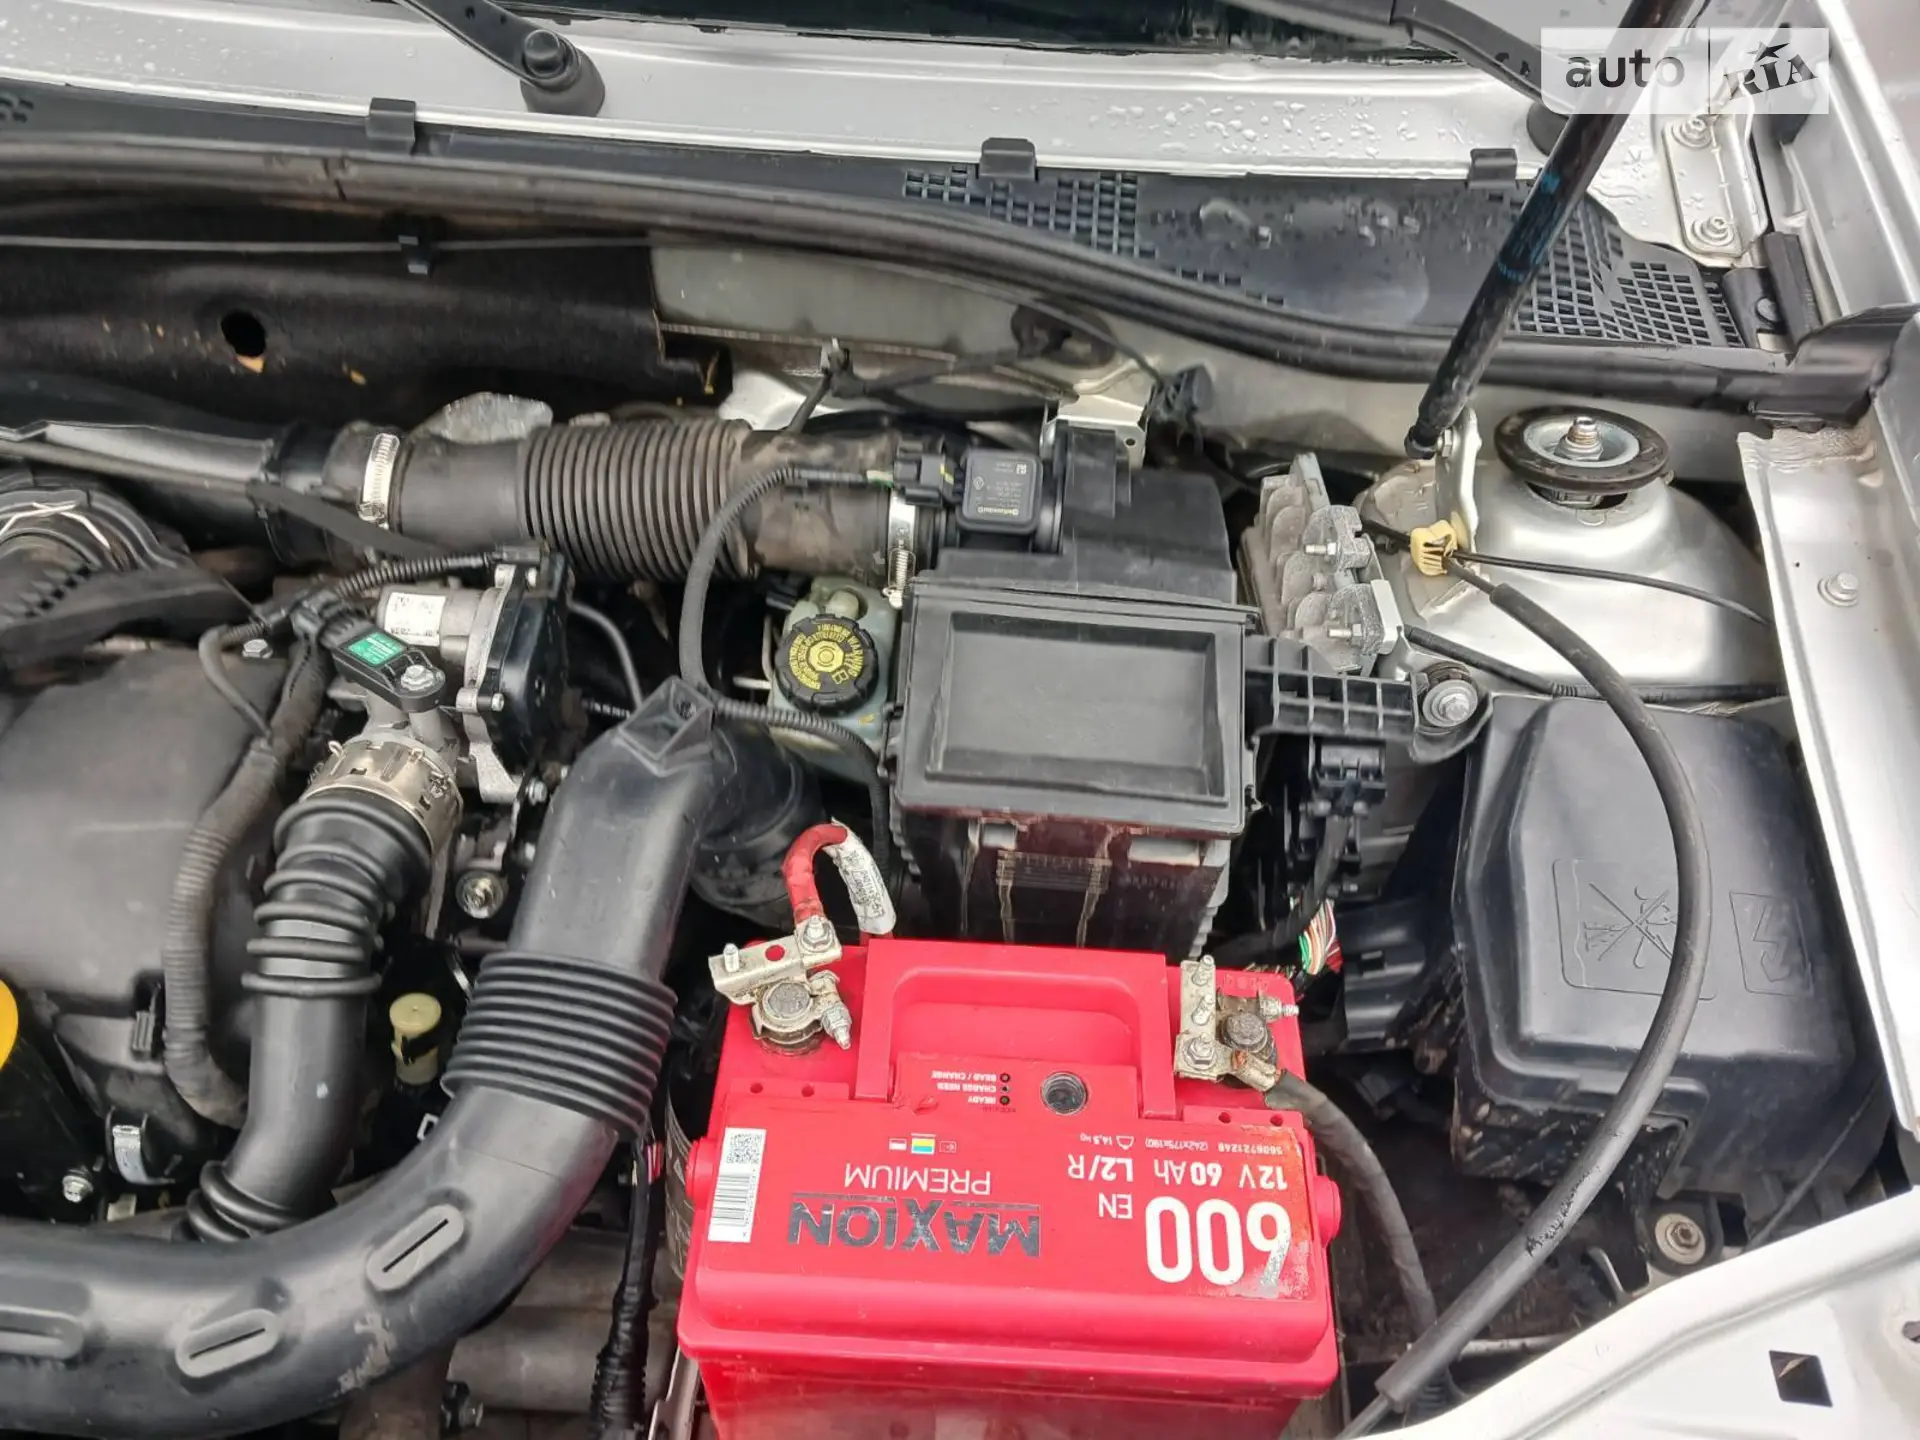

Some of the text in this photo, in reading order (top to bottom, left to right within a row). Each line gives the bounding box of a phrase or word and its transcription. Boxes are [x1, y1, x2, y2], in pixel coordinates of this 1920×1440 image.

[844, 1163, 991, 1195] PREMIUM
[787, 1198, 1041, 1258] MAXION
[1098, 1192, 1292, 1287] 600 EN
